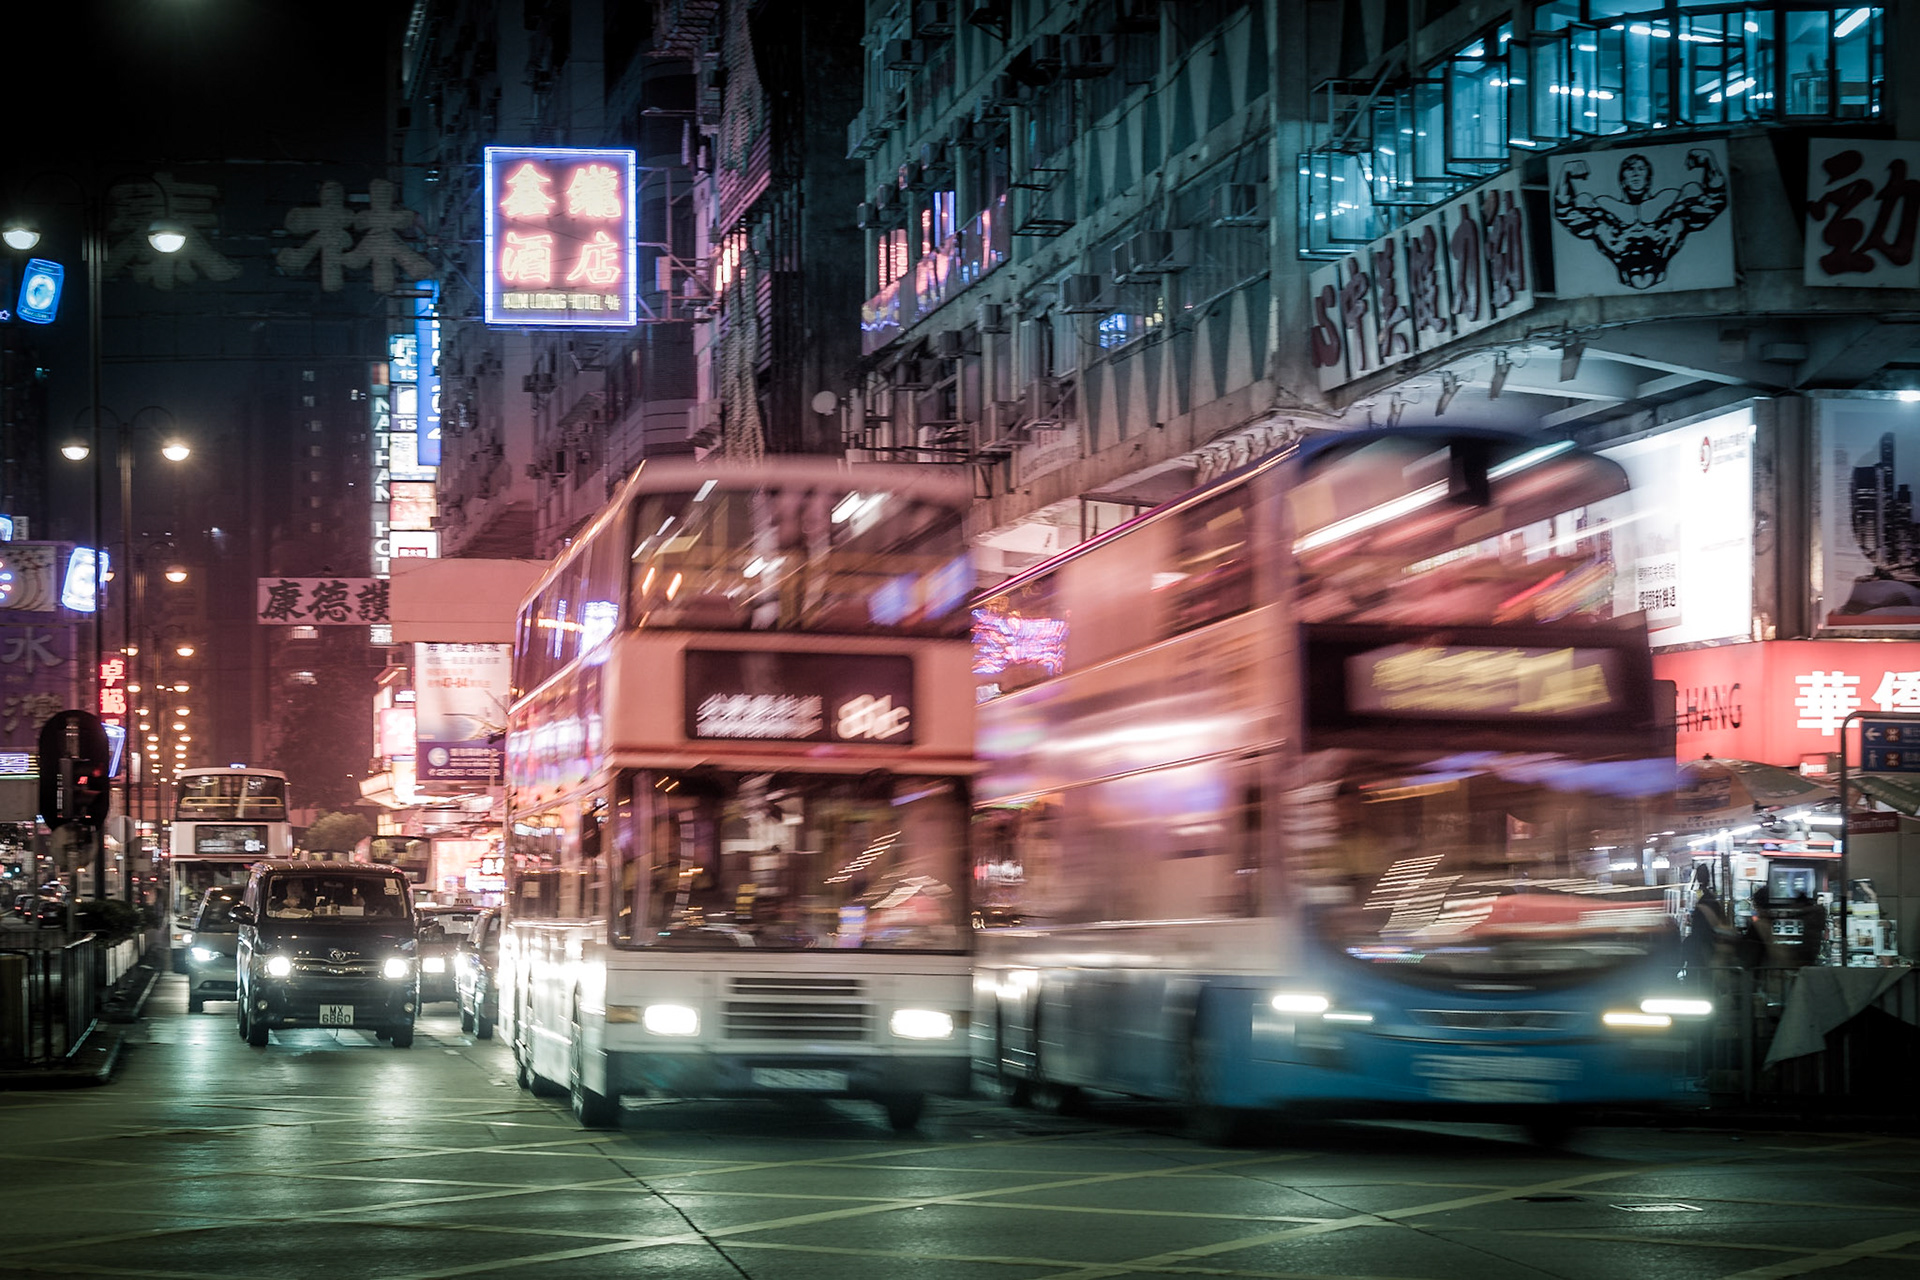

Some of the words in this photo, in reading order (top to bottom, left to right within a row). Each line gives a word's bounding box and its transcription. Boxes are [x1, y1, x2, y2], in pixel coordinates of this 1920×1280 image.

[102, 172, 436, 292] 泰林
[502, 232, 621, 284] 酒店
[329, 1005, 344, 1015] MX
